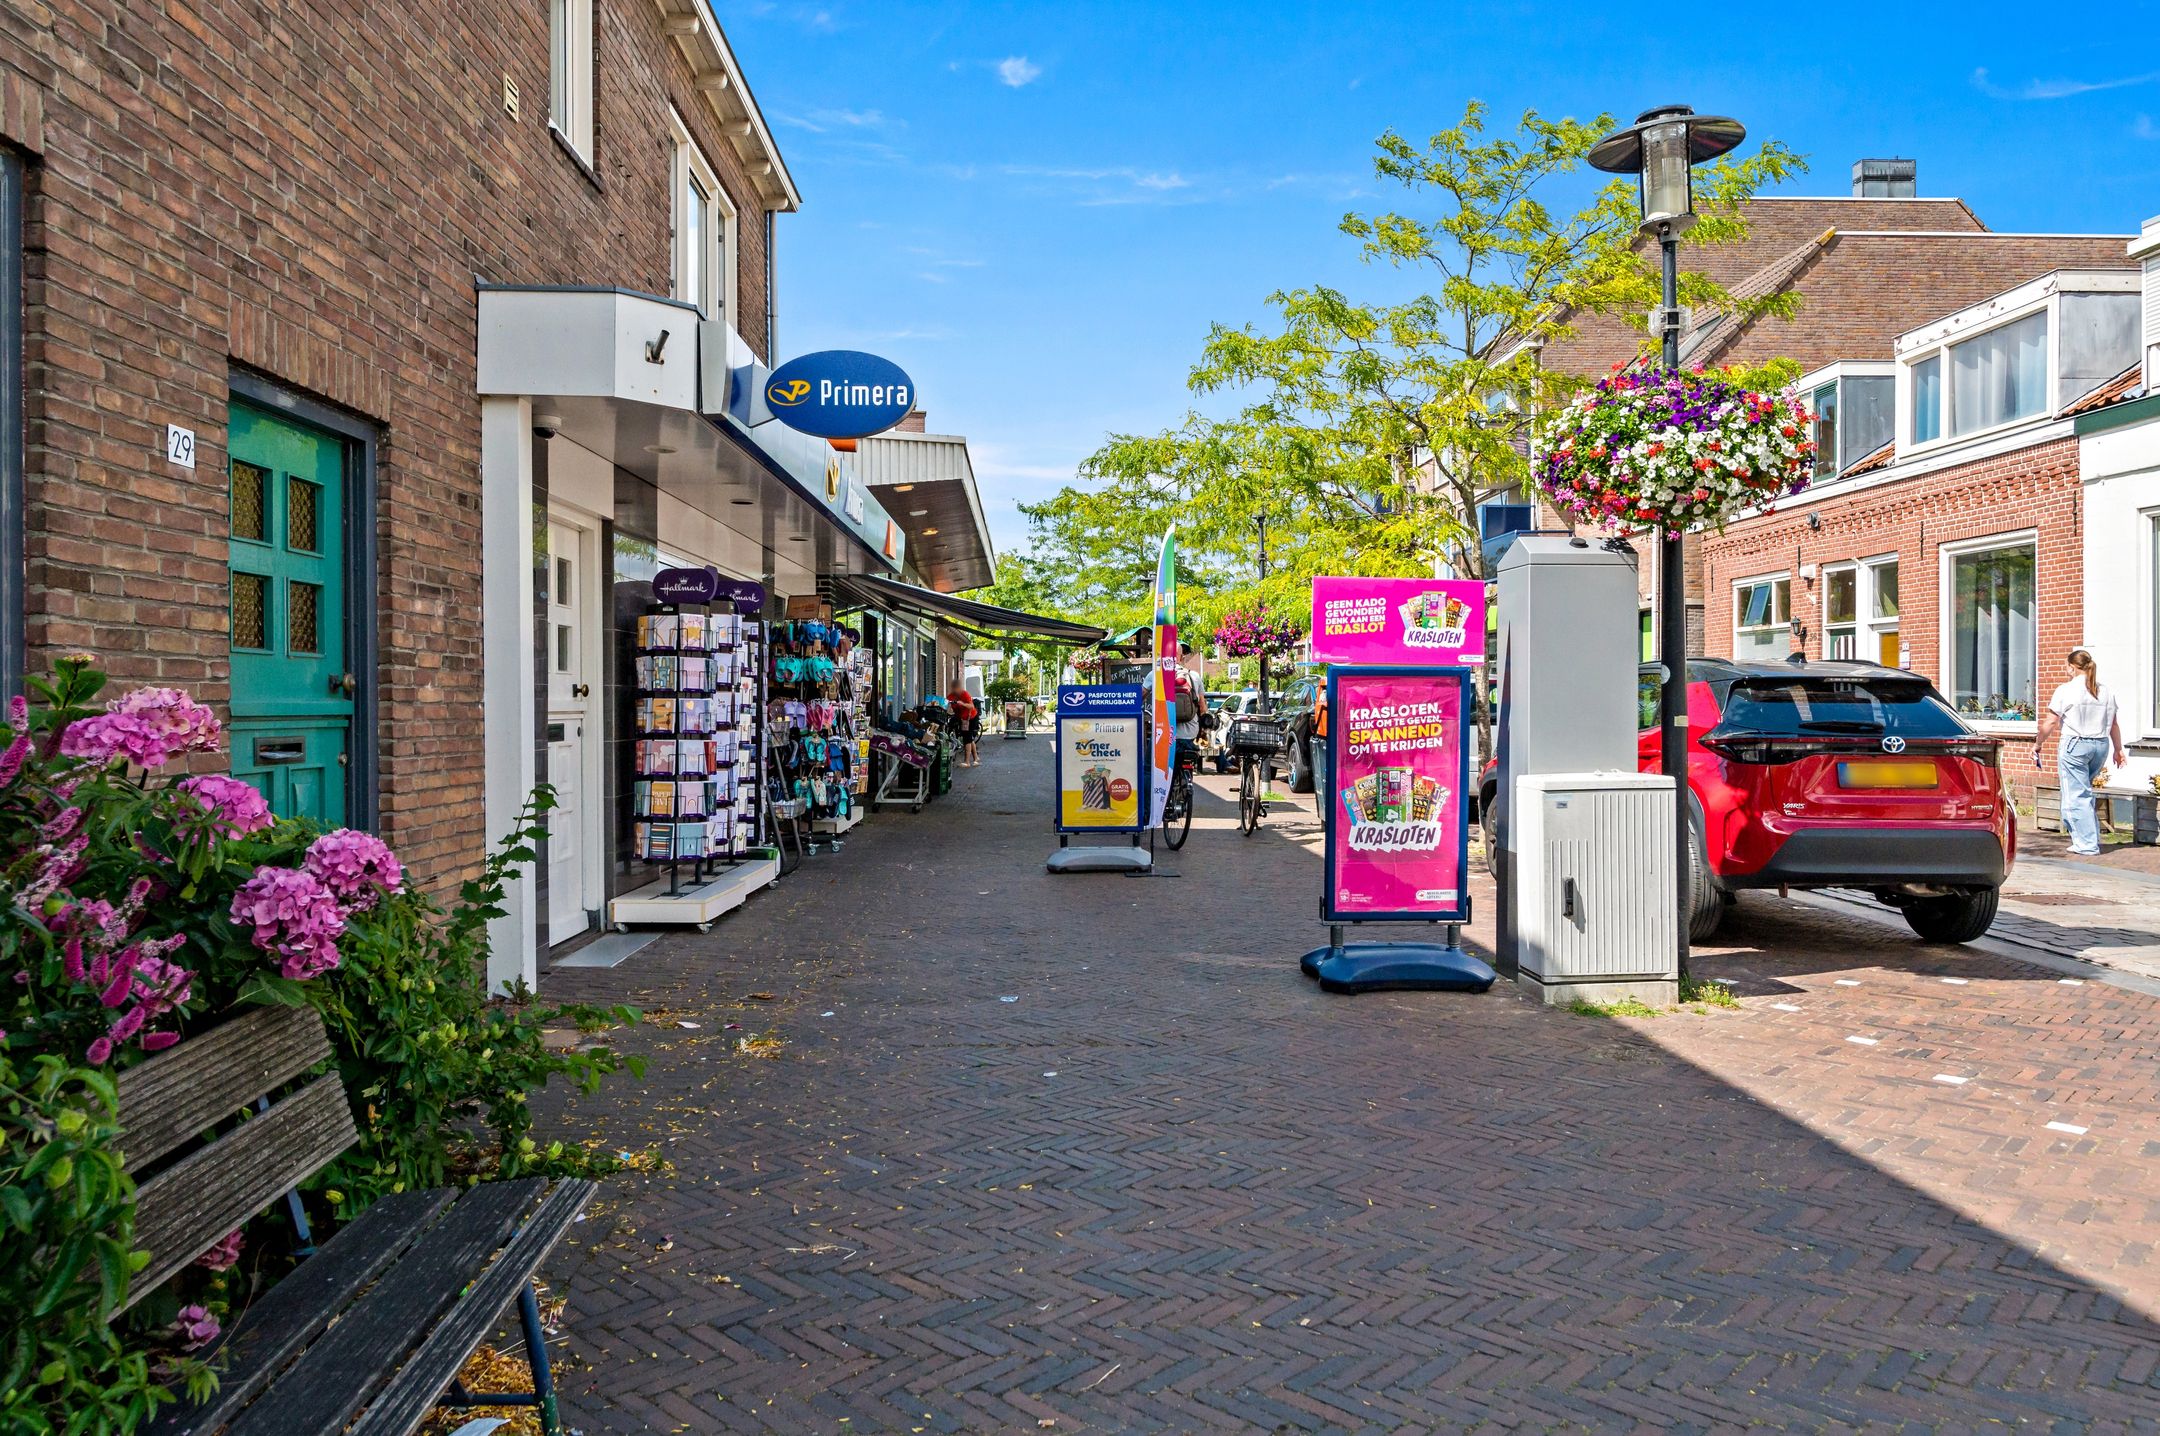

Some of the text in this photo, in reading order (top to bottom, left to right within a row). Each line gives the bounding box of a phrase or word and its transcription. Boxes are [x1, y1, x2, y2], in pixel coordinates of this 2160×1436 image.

[820, 380, 908, 406] Primera
[172, 430, 192, 462] 29
[659, 581, 708, 596] Hallmark
[1325, 597, 1387, 610] GEEN KADO
[1325, 606, 1387, 618] GEVONDEN?
[1325, 617, 1348, 625] DENK
[1369, 614, 1386, 622] EEN
[1325, 621, 1386, 636] KRASLOT
[1407, 630, 1462, 644] KRASLOTEN
[1349, 702, 1443, 721] KRASLOTEN.
[1095, 722, 1125, 733] Primera
[1350, 720, 1375, 730] LEUK
[1376, 719, 1392, 728] OM
[1394, 717, 1405, 726] TE
[1349, 723, 1443, 744] SPANNEND
[1091, 748, 1121, 757] check
[1349, 736, 1443, 755] OM TE KRIJGEN
[1354, 824, 1437, 846] KRASLOTEN
